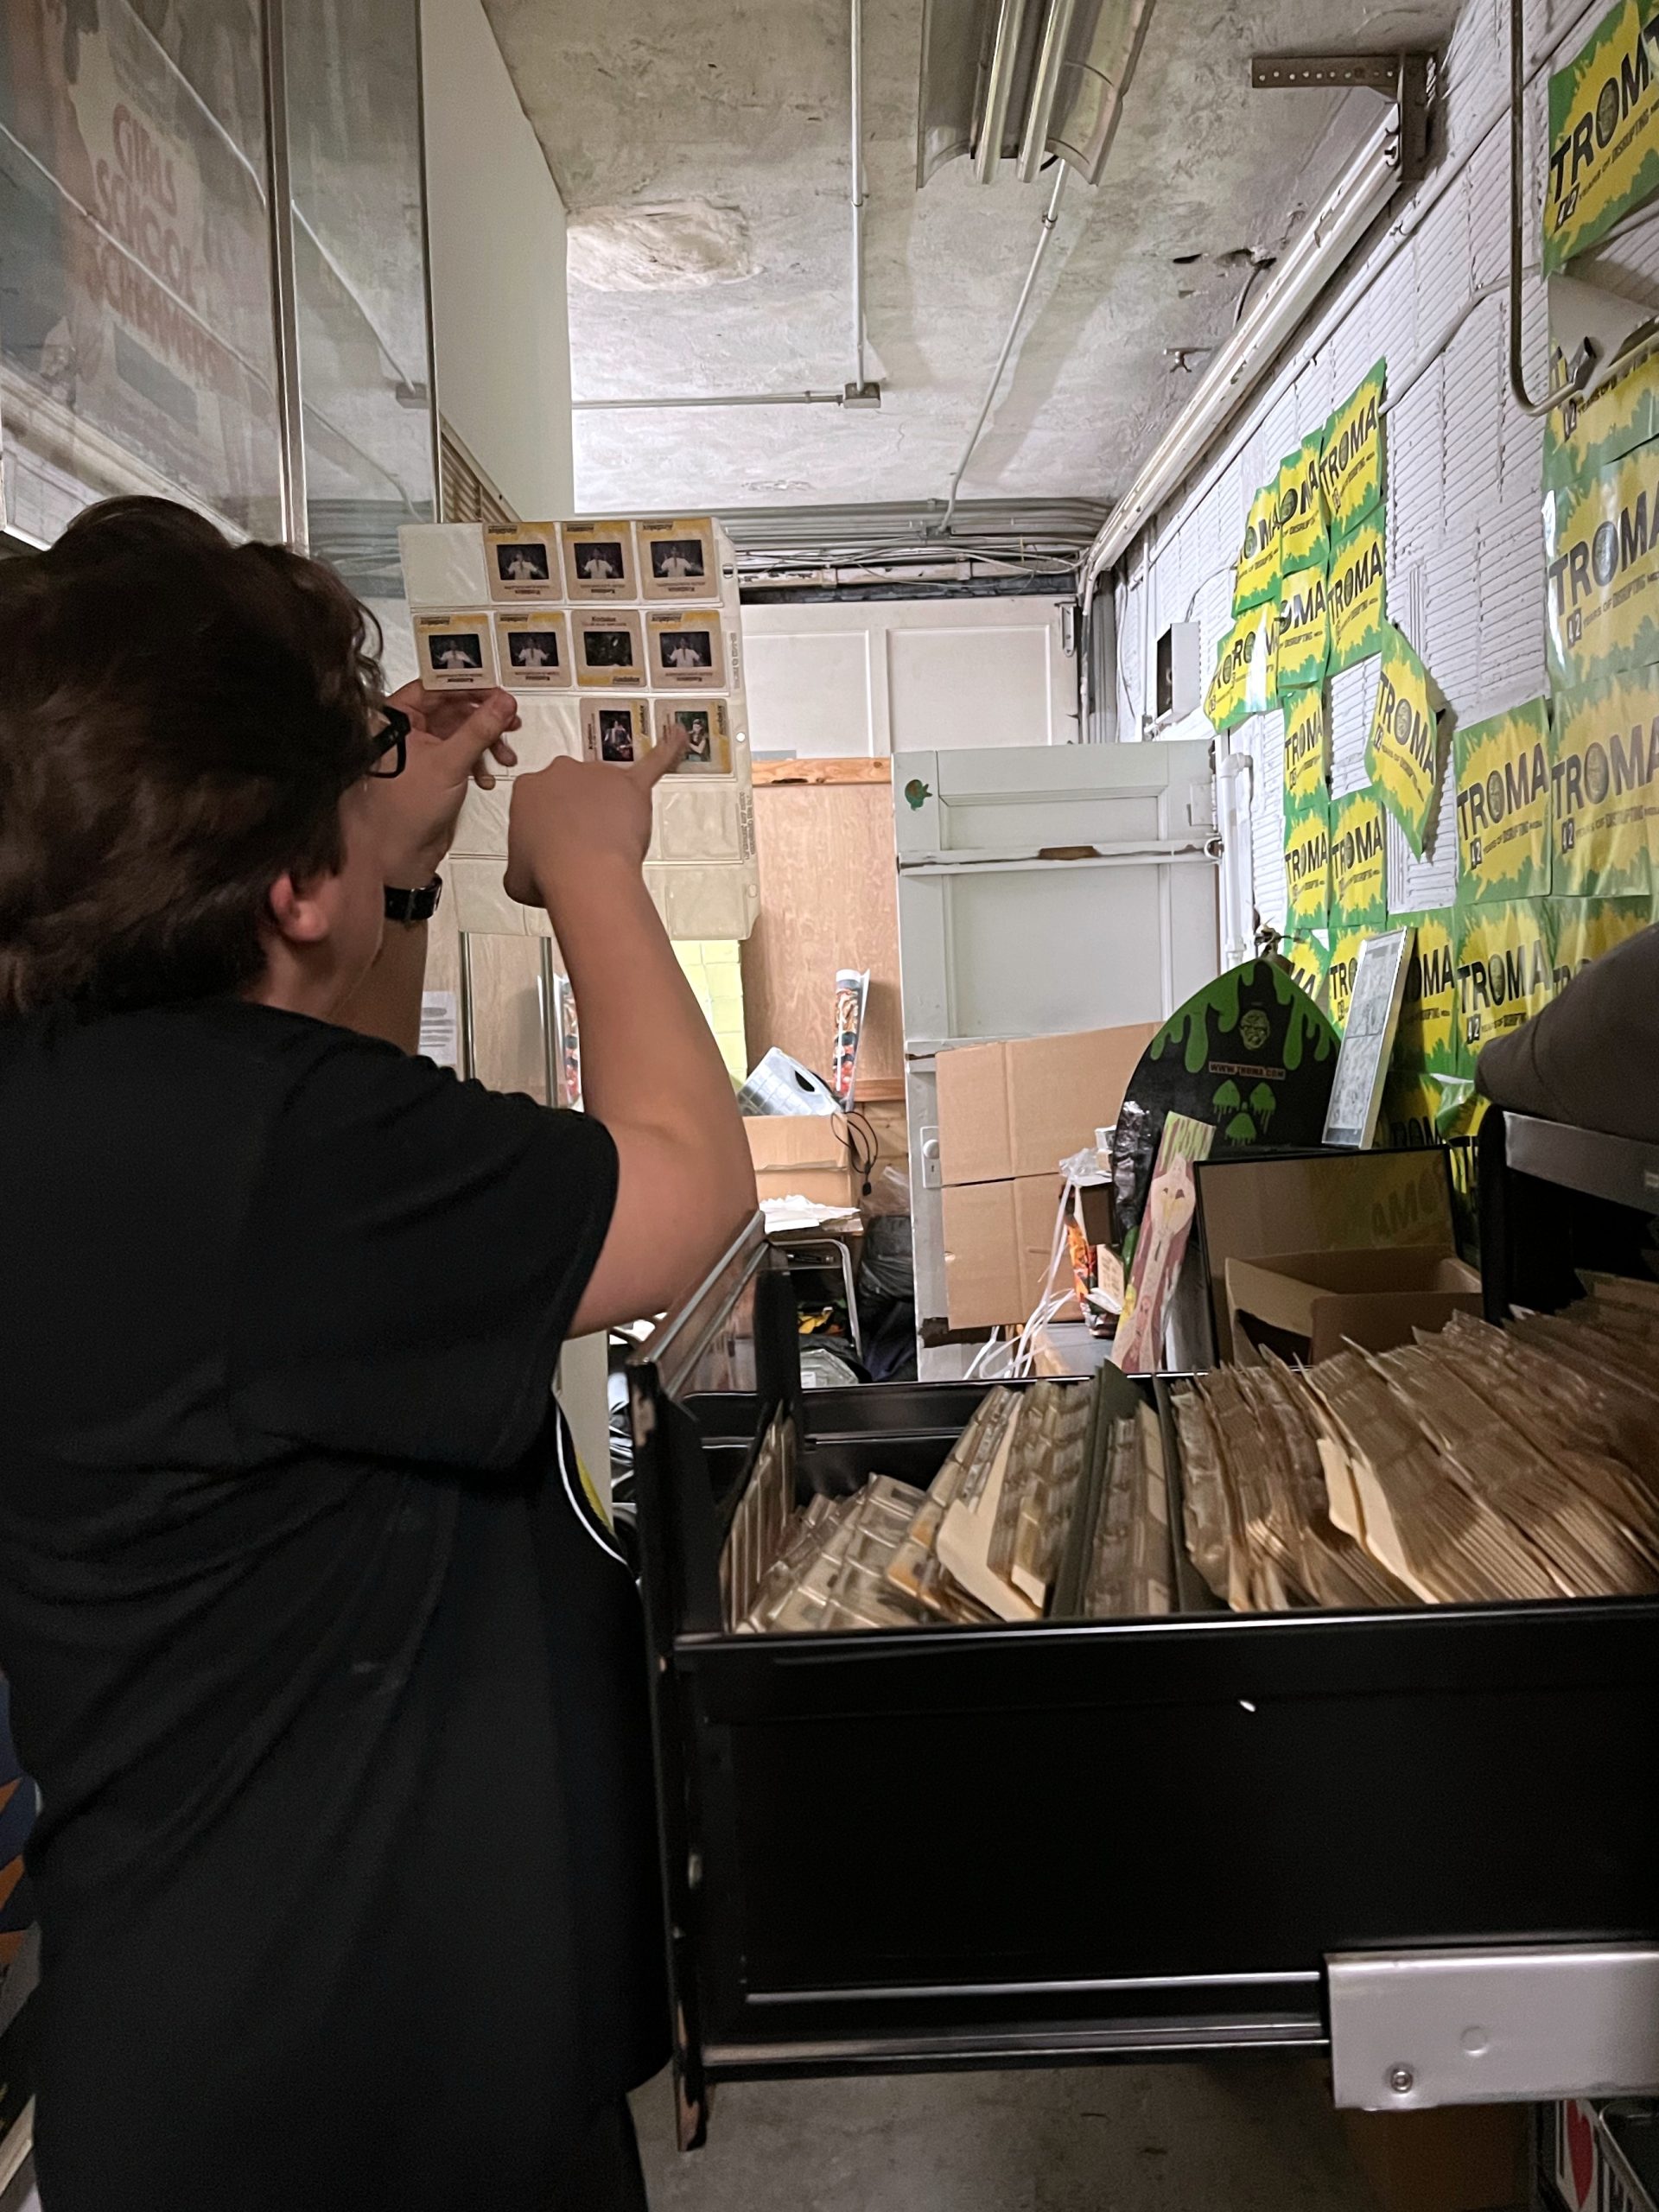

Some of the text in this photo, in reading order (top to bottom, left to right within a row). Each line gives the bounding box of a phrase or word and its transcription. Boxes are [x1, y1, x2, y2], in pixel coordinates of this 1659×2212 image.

[1551, 32, 1653, 204] TROM
[1319, 396, 1376, 496] TROMA
[1327, 542, 1382, 625] TROMA
[1285, 705, 1323, 771] TROMA
[1379, 677, 1434, 786] TROMA
[1457, 743, 1549, 841] TROMA
[1285, 832, 1328, 885] TROMA
[1331, 816, 1382, 880] TROMA
[1330, 957, 1358, 1000] TRO
[1458, 939, 1552, 1014] TROMA
